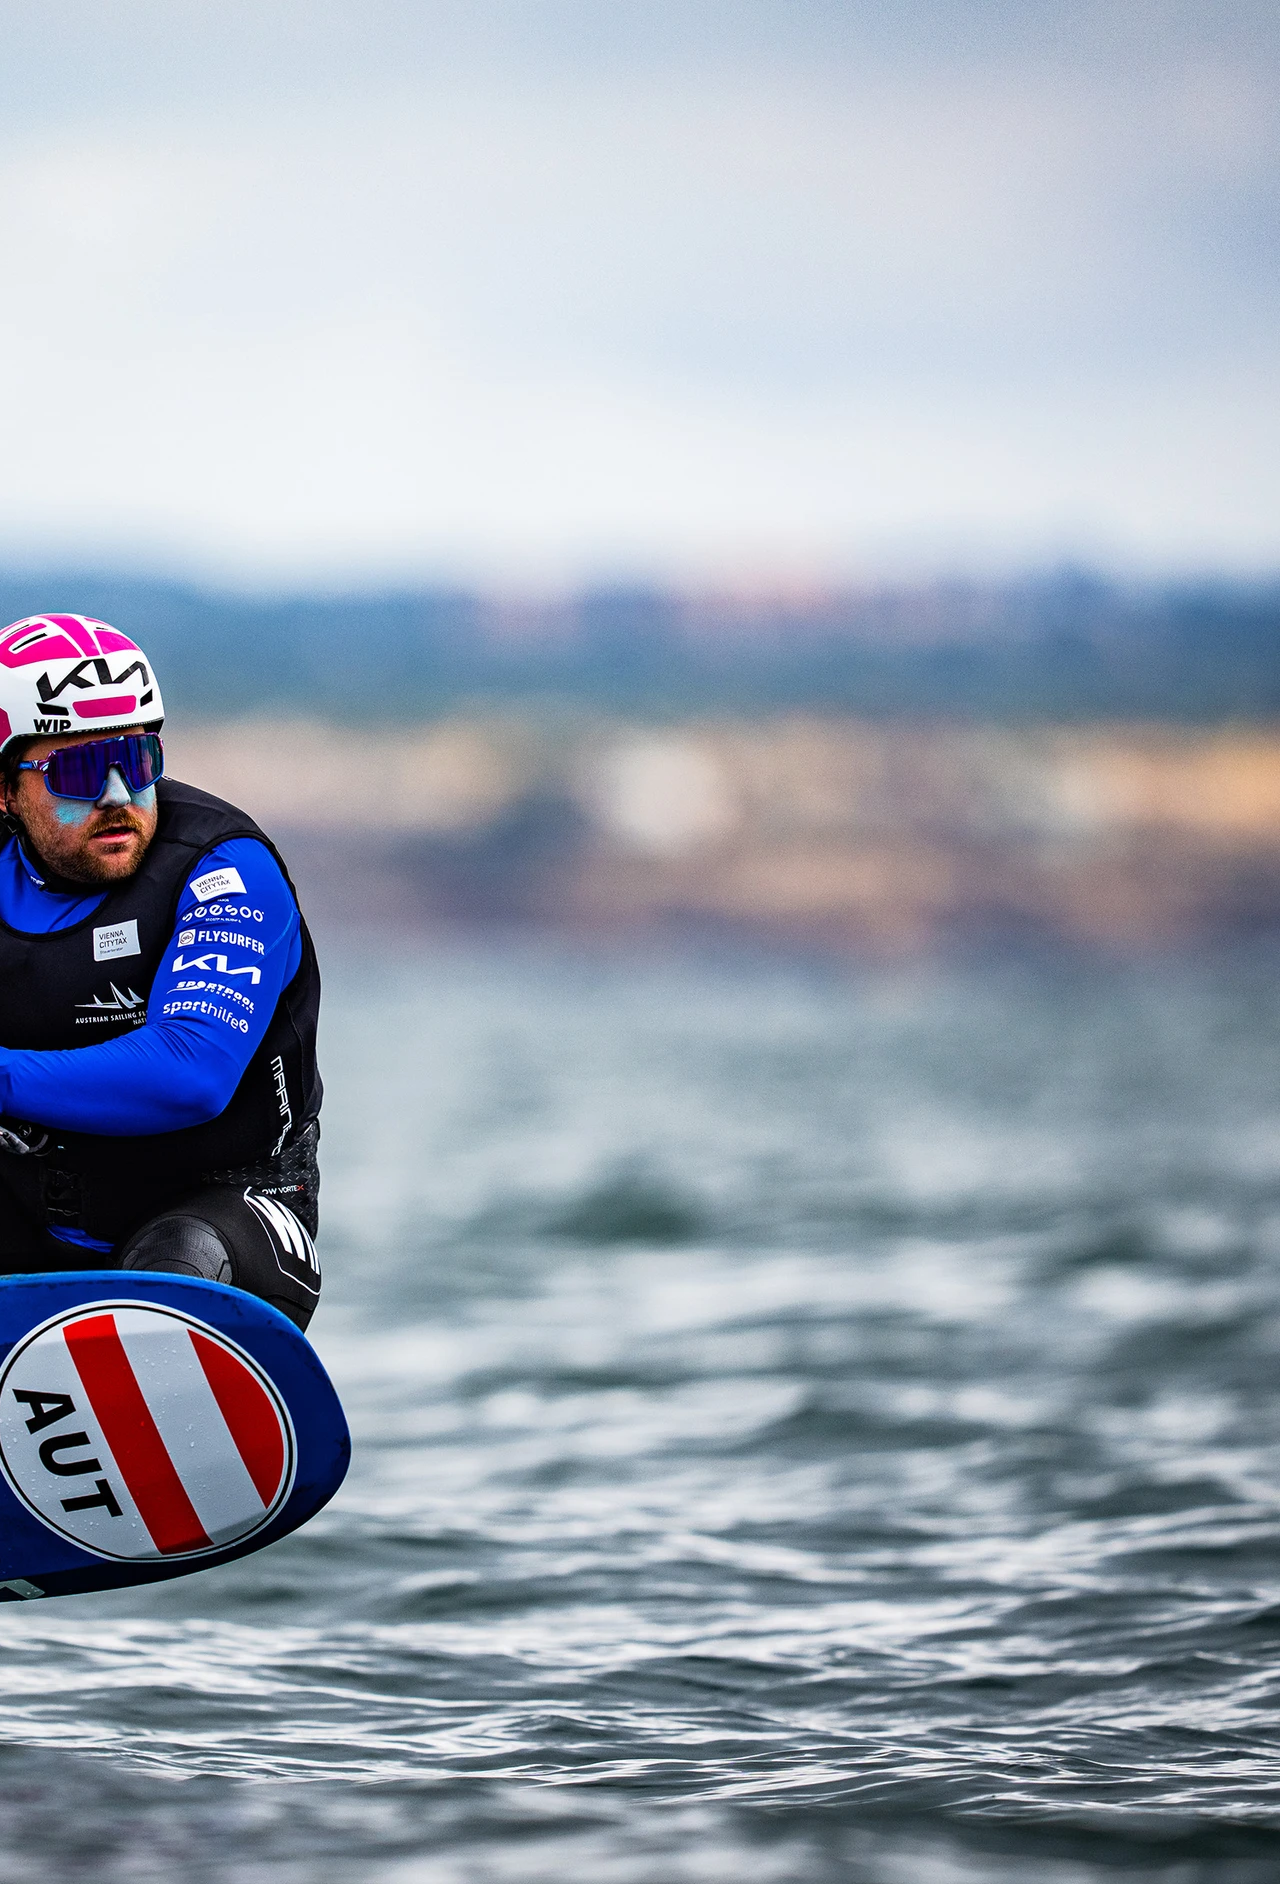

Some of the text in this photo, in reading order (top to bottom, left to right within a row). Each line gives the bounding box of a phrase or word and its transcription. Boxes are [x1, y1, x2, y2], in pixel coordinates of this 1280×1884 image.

[36, 658, 149, 702] KIA
[33, 719, 71, 732] WIP
[196, 874, 225, 888] VIENNA
[200, 879, 231, 894] CITYTAX
[182, 904, 264, 923] seesoo
[99, 929, 124, 940] VIENNA
[99, 936, 128, 949] CITYTAX
[198, 930, 265, 956] FLYSURFER
[172, 953, 262, 985] KIA
[75, 1014, 109, 1025] AUSTRIAN
[110, 1011, 137, 1022] SAILING
[163, 1000, 239, 1030] sporthilfe
[278, 1184, 305, 1195] VORTEX
[12, 1388, 124, 1518] AUT
